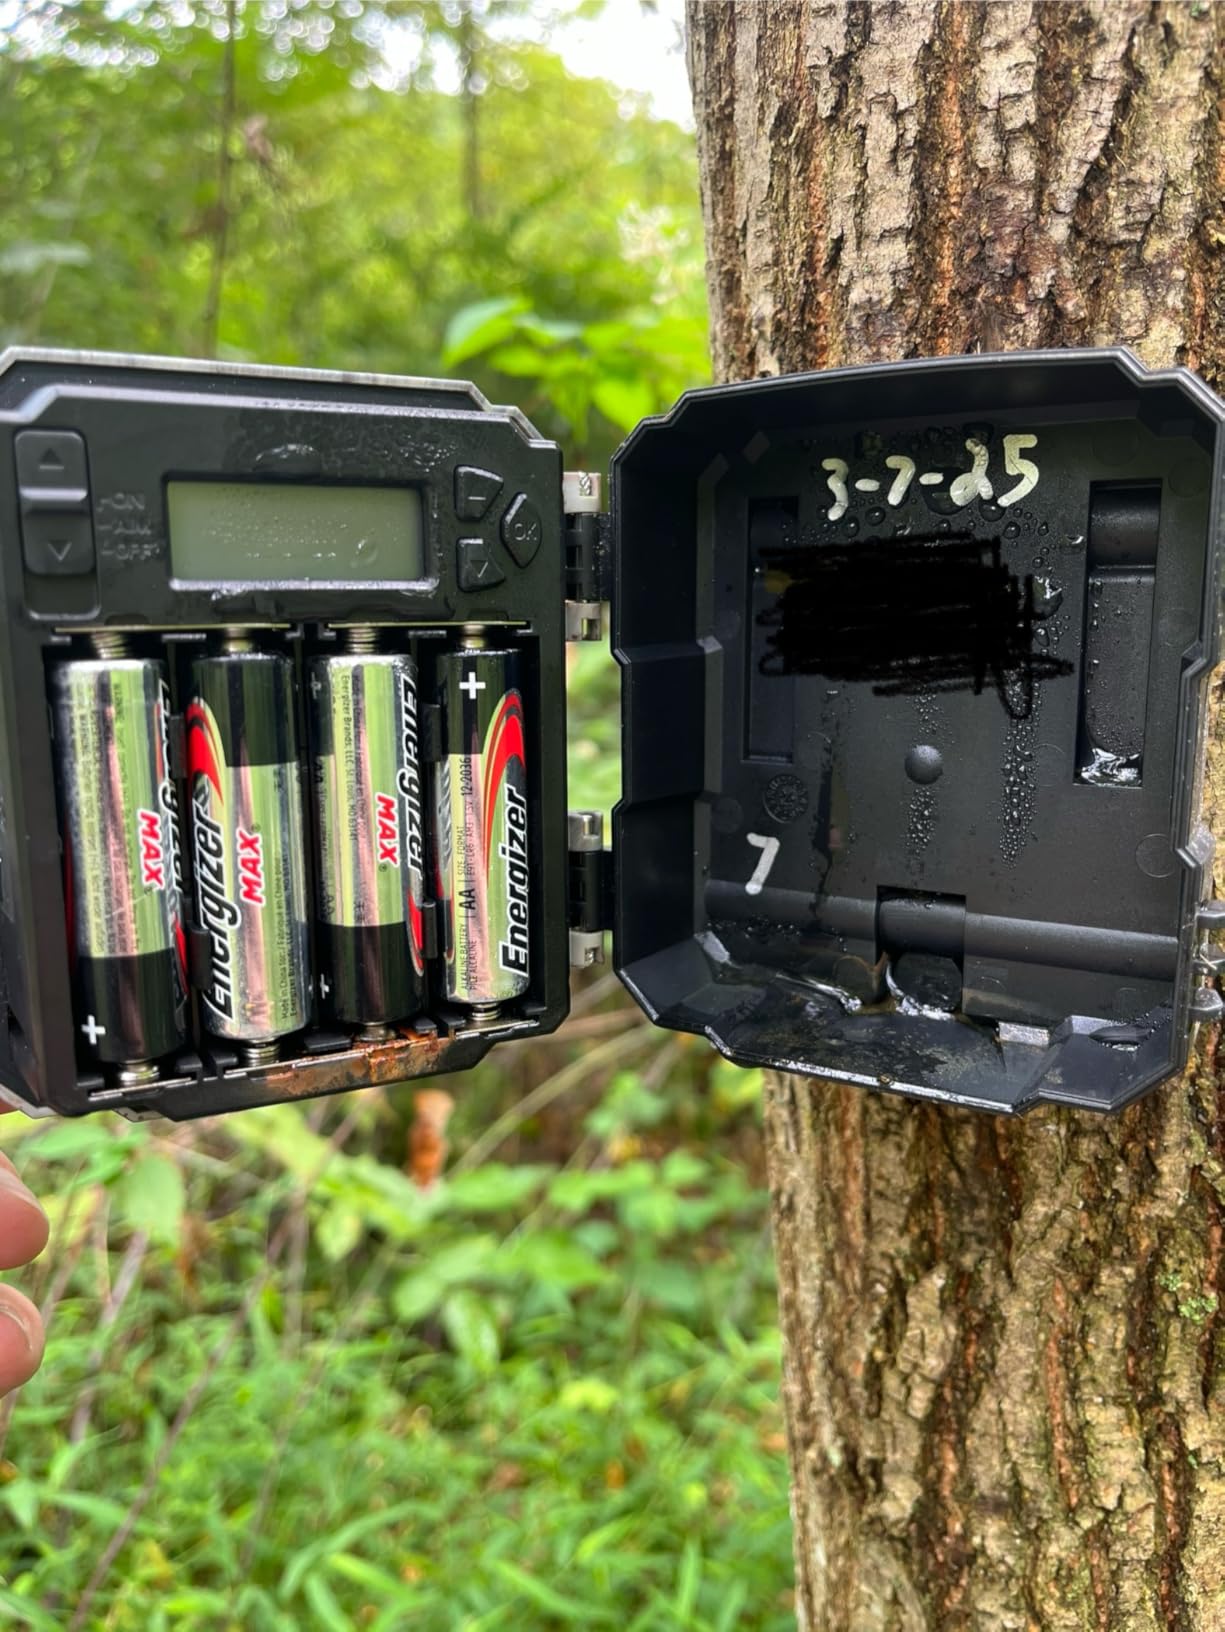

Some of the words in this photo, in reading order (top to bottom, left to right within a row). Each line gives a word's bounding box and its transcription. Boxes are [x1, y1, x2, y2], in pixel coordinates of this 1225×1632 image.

[821, 433, 1040, 521] 3-7-25
[514, 522, 537, 541] OK
[341, 675, 350, 715] Energizer
[459, 757, 473, 796] 12-2036
[499, 783, 529, 977] Energizer
[744, 832, 781, 895] 7
[458, 888, 476, 910] AA
[459, 923, 468, 954] BATTERY
[468, 941, 477, 973] ALCALINE
[460, 955, 469, 990] ALKALINE
